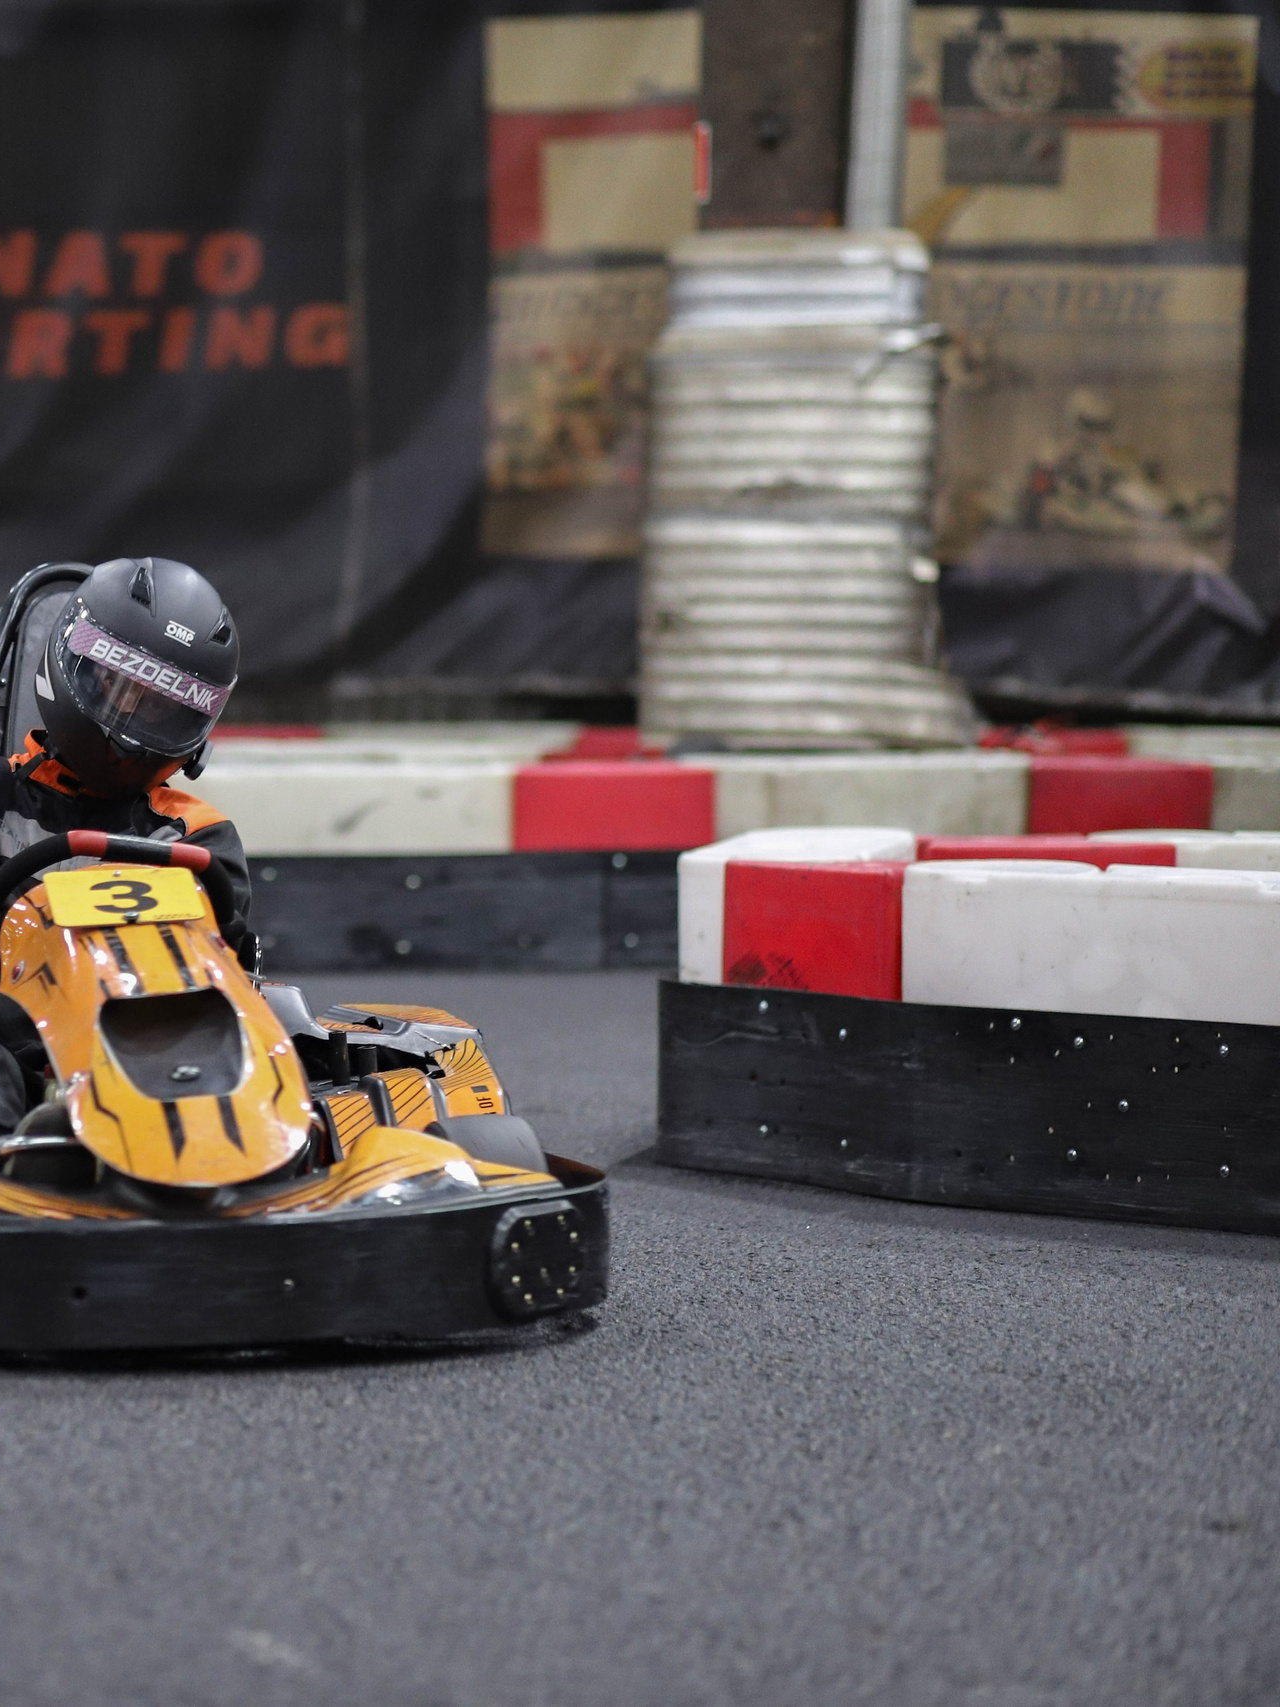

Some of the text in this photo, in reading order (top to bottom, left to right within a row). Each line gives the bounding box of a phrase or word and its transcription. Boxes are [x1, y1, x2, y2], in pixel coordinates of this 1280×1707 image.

[165, 623, 195, 644] OMP
[88, 638, 219, 711] BEZDELNIK
[89, 880, 159, 914] 3
